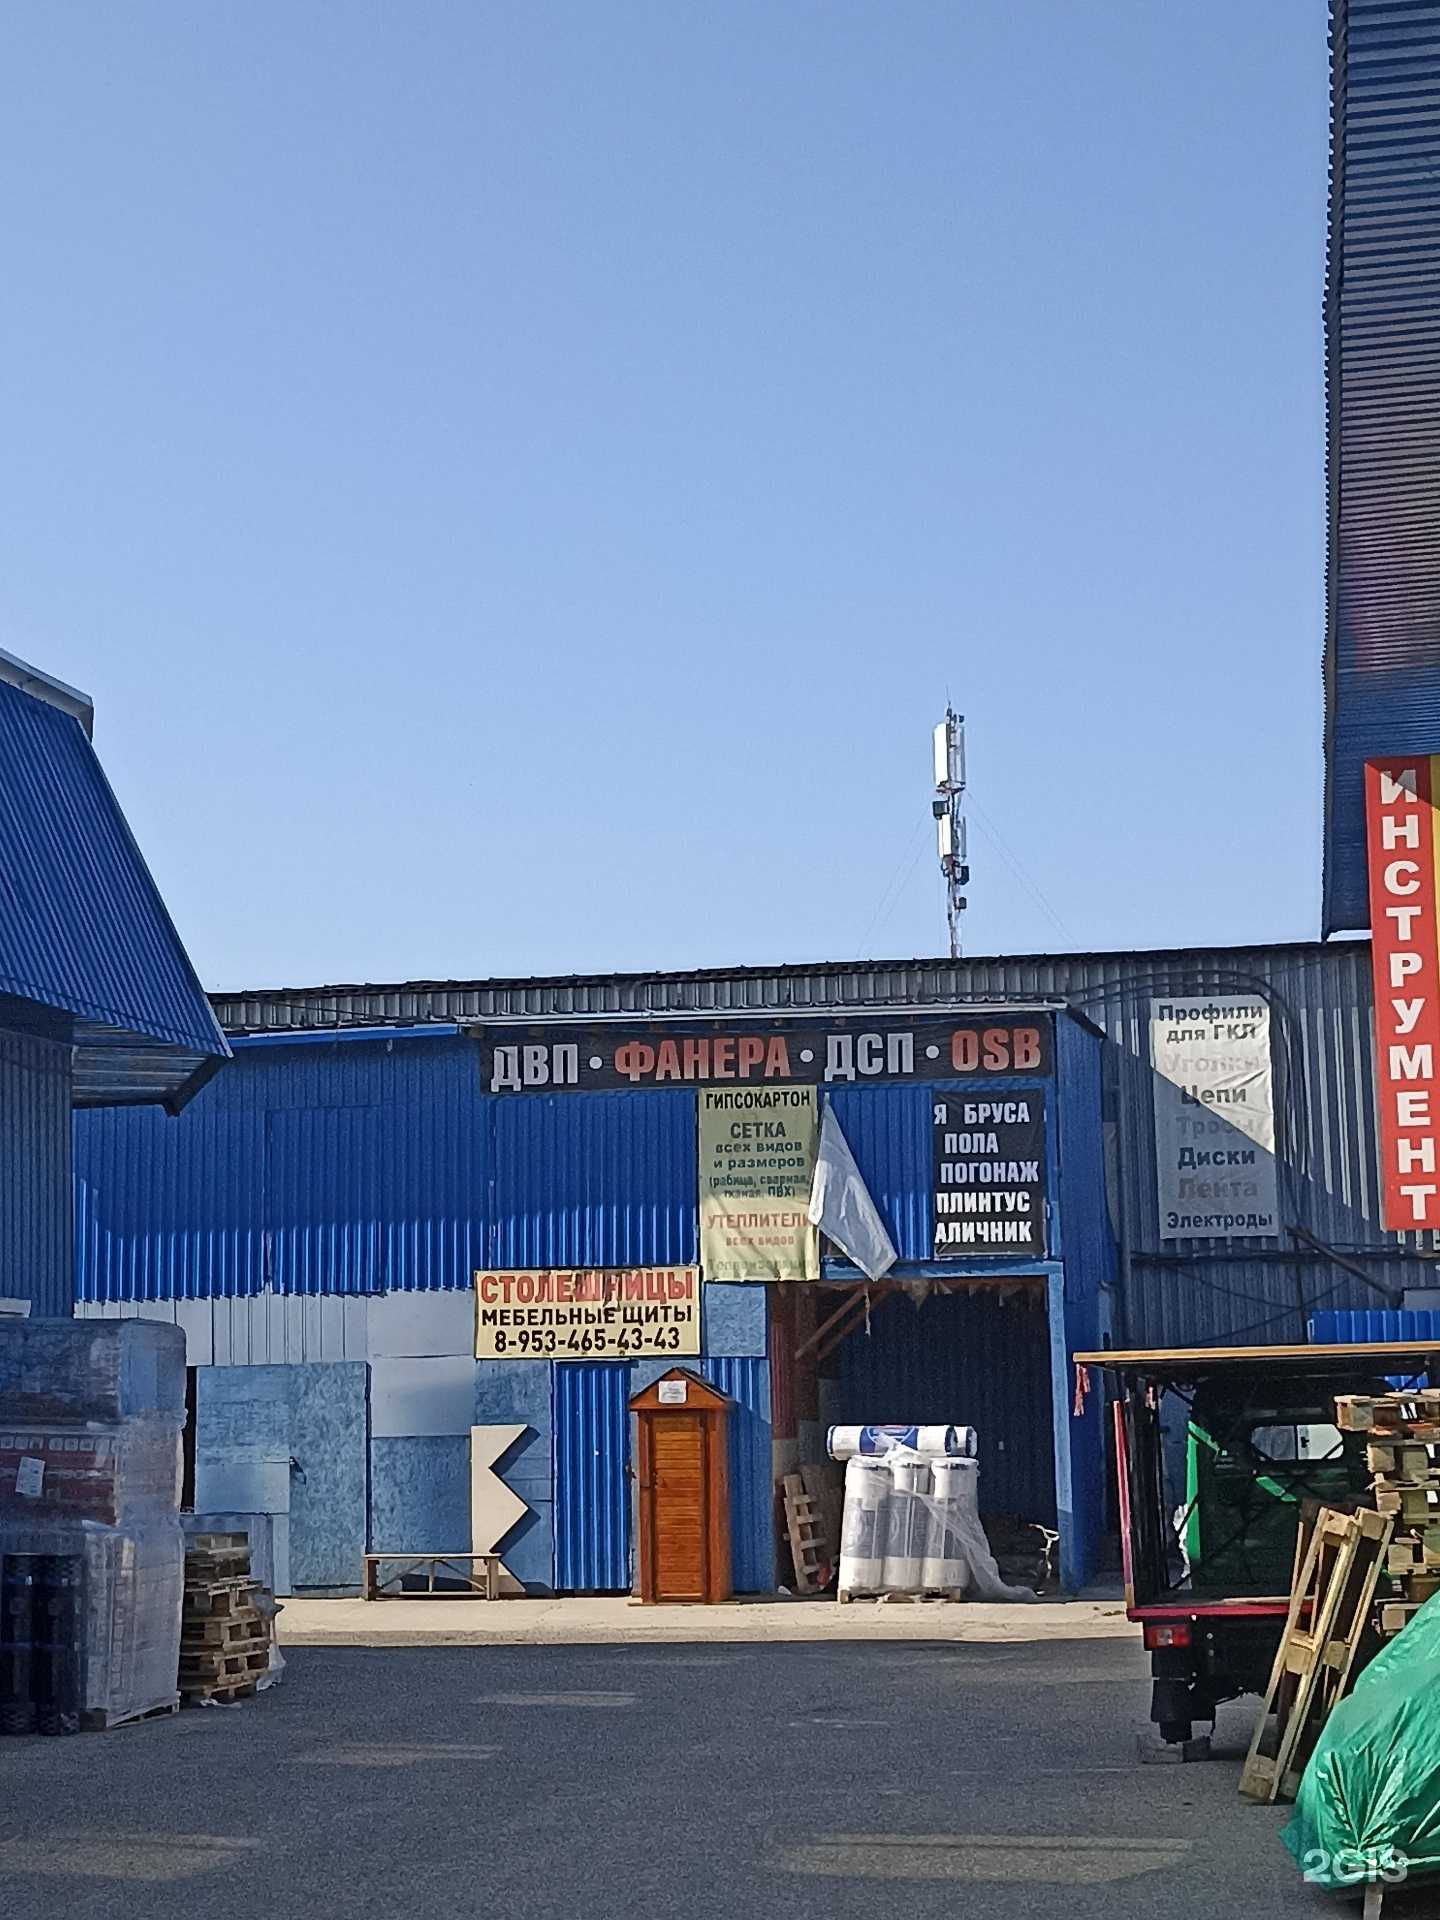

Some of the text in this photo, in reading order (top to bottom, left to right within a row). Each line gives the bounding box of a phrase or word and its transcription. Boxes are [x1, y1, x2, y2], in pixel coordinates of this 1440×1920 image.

[1380, 768, 1437, 1220] ИНСТРУМЕНТ
[1159, 1003, 1263, 1024] Профили
[1166, 1029, 1206, 1044] для
[490, 1028, 1041, 1092] ДВП ФАНЕРА ДСП OSB
[705, 1090, 810, 1110] ГИПСОКАРТОН
[1180, 1085, 1247, 1107] Цепи
[964, 1102, 1030, 1124] БРУСА
[730, 1121, 786, 1138] СЕТКА
[715, 1141, 803, 1154] всех видов
[944, 1132, 999, 1154] ПОЛА
[713, 1157, 805, 1171] и размеров
[1178, 1147, 1256, 1170] Диски
[940, 1160, 1039, 1183] ПОГОНАЖ
[936, 1191, 1030, 1213] ПЛИНТУС
[1167, 1211, 1272, 1231] Электроды
[934, 1221, 1032, 1244] АЛИЧНИК
[481, 1305, 692, 1326] МЕБЕЛЬНЫЕ ЩИТЫ
[494, 1327, 680, 1353] 8-953-465-43-43
